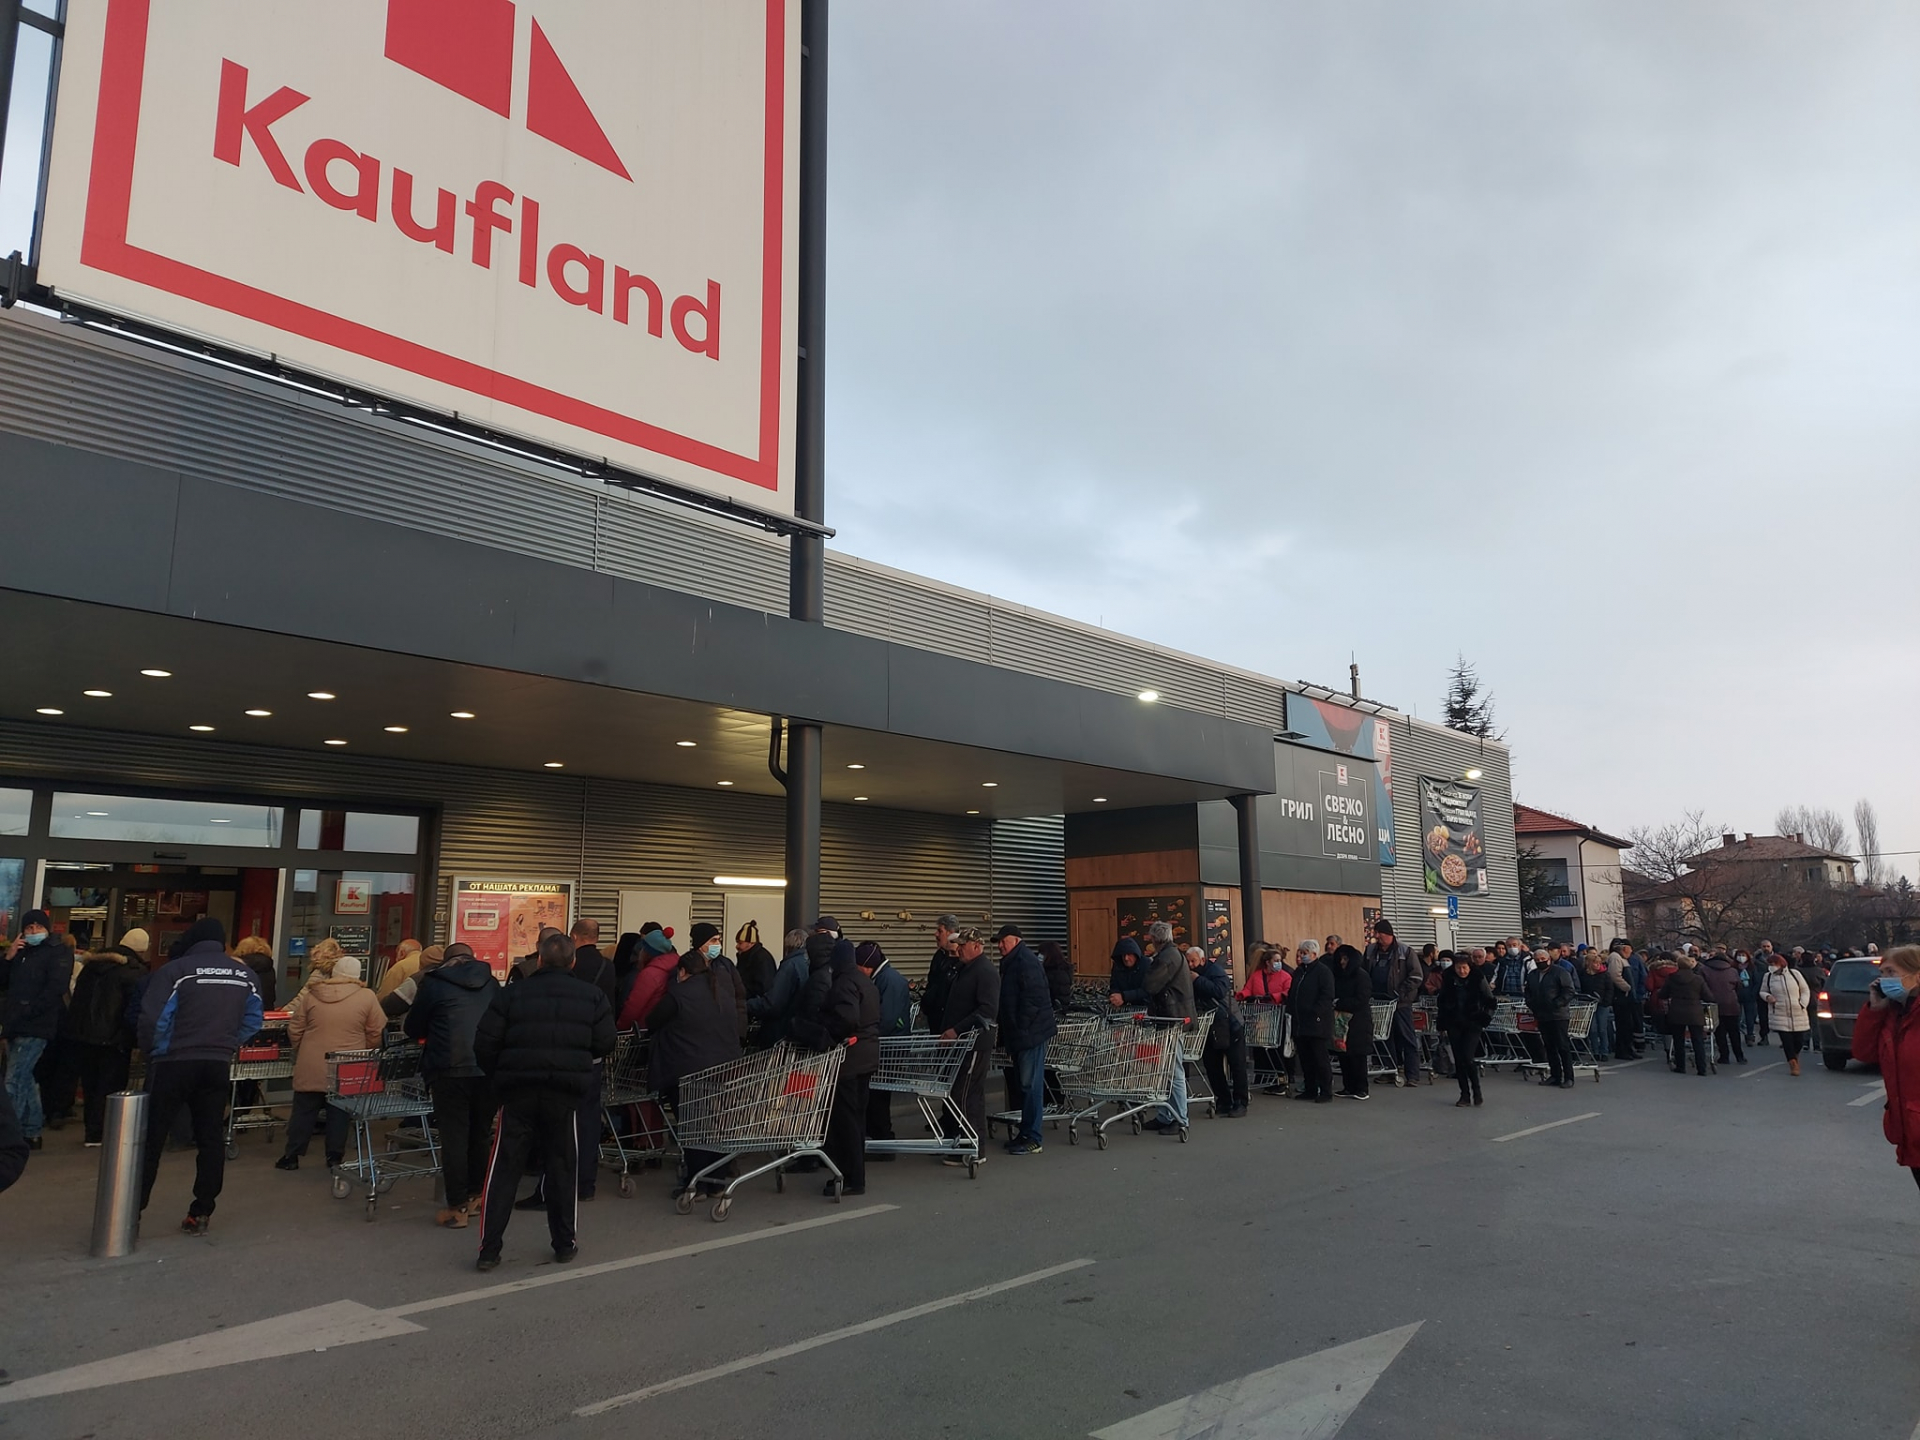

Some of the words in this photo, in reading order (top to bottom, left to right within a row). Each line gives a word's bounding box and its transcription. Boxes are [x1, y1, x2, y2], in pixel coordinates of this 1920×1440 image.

[214, 57, 721, 361] Kaufland
[1281, 798, 1314, 821] ГРИЛ
[1325, 794, 1363, 817] СВЕЖО
[1327, 823, 1365, 845] ЛЕСНО
[483, 883, 517, 891] НАШАТА
